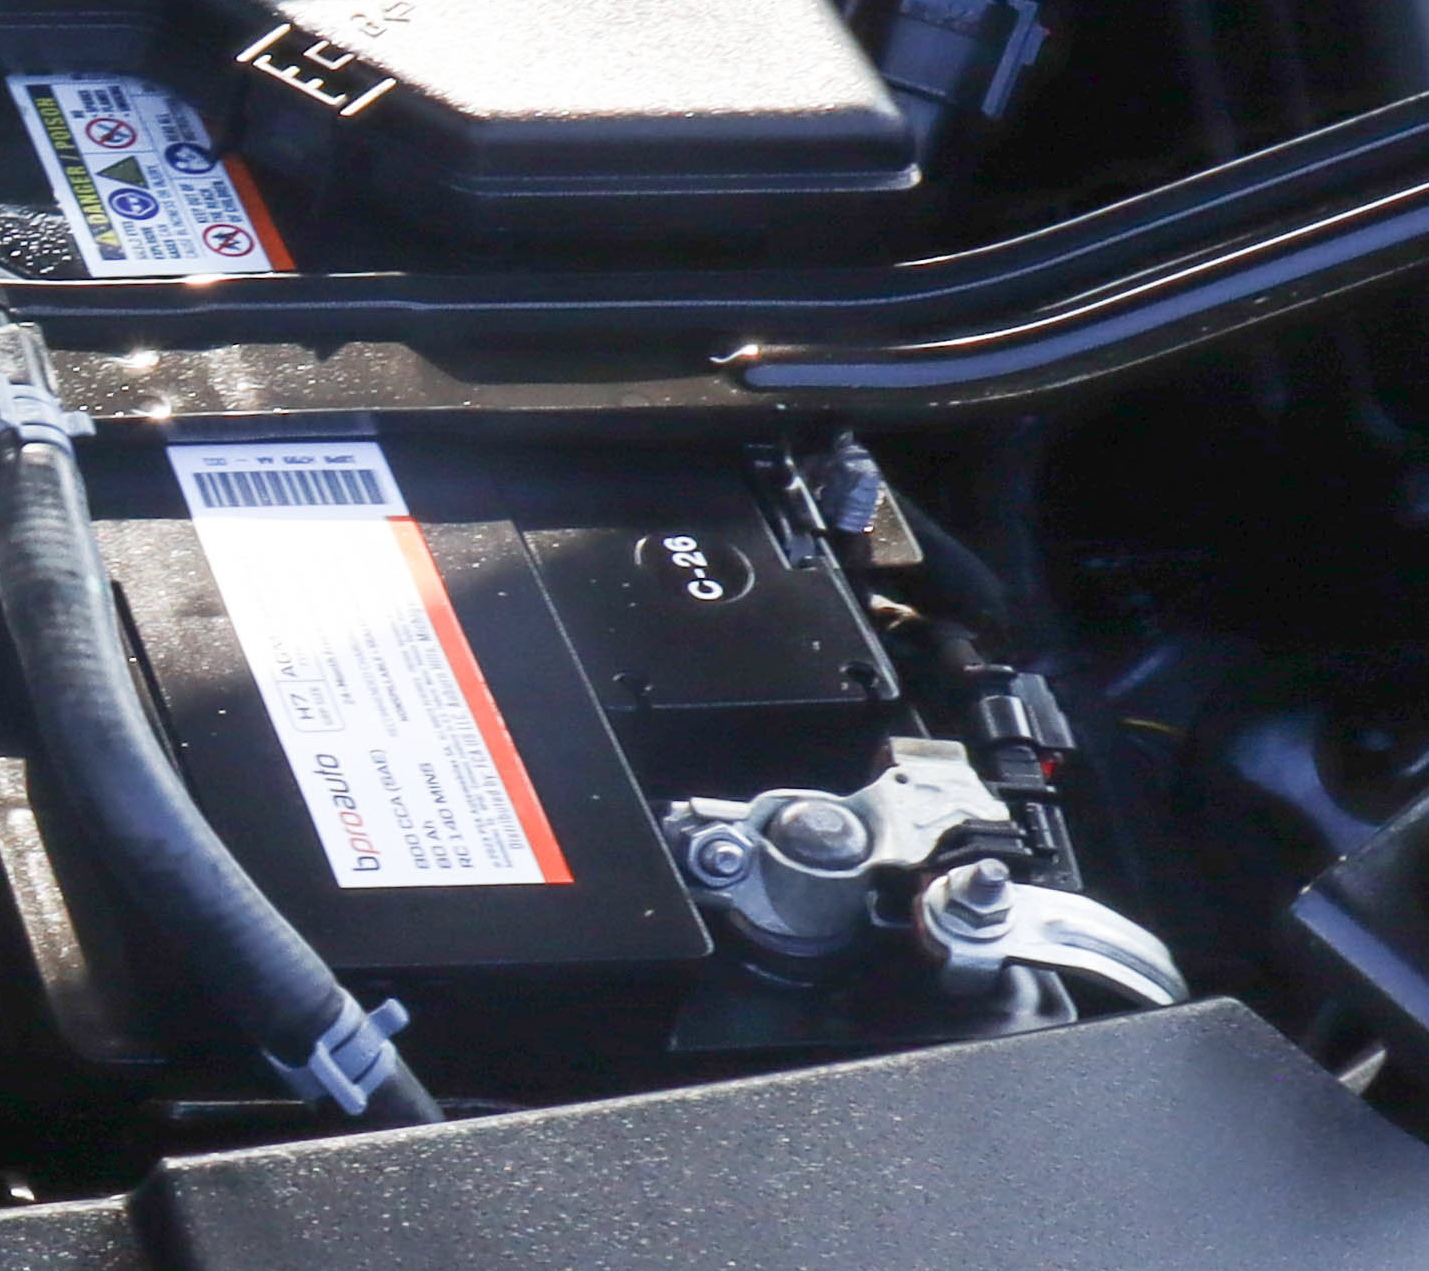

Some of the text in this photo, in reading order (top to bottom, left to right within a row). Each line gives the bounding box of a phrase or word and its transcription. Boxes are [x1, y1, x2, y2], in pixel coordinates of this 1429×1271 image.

[35, 98, 73, 148] POISON
[66, 166, 107, 222] DANGER
[663, 536, 723, 600] C-26
[289, 693, 314, 719] H7
[368, 749, 399, 790] (SAE)
[417, 762, 446, 803] MINS
[312, 754, 381, 872] bproauto
[387, 796, 413, 828] CCA
[419, 820, 439, 840] Ah
[437, 808, 462, 840] 140
[453, 845, 474, 867] RC
